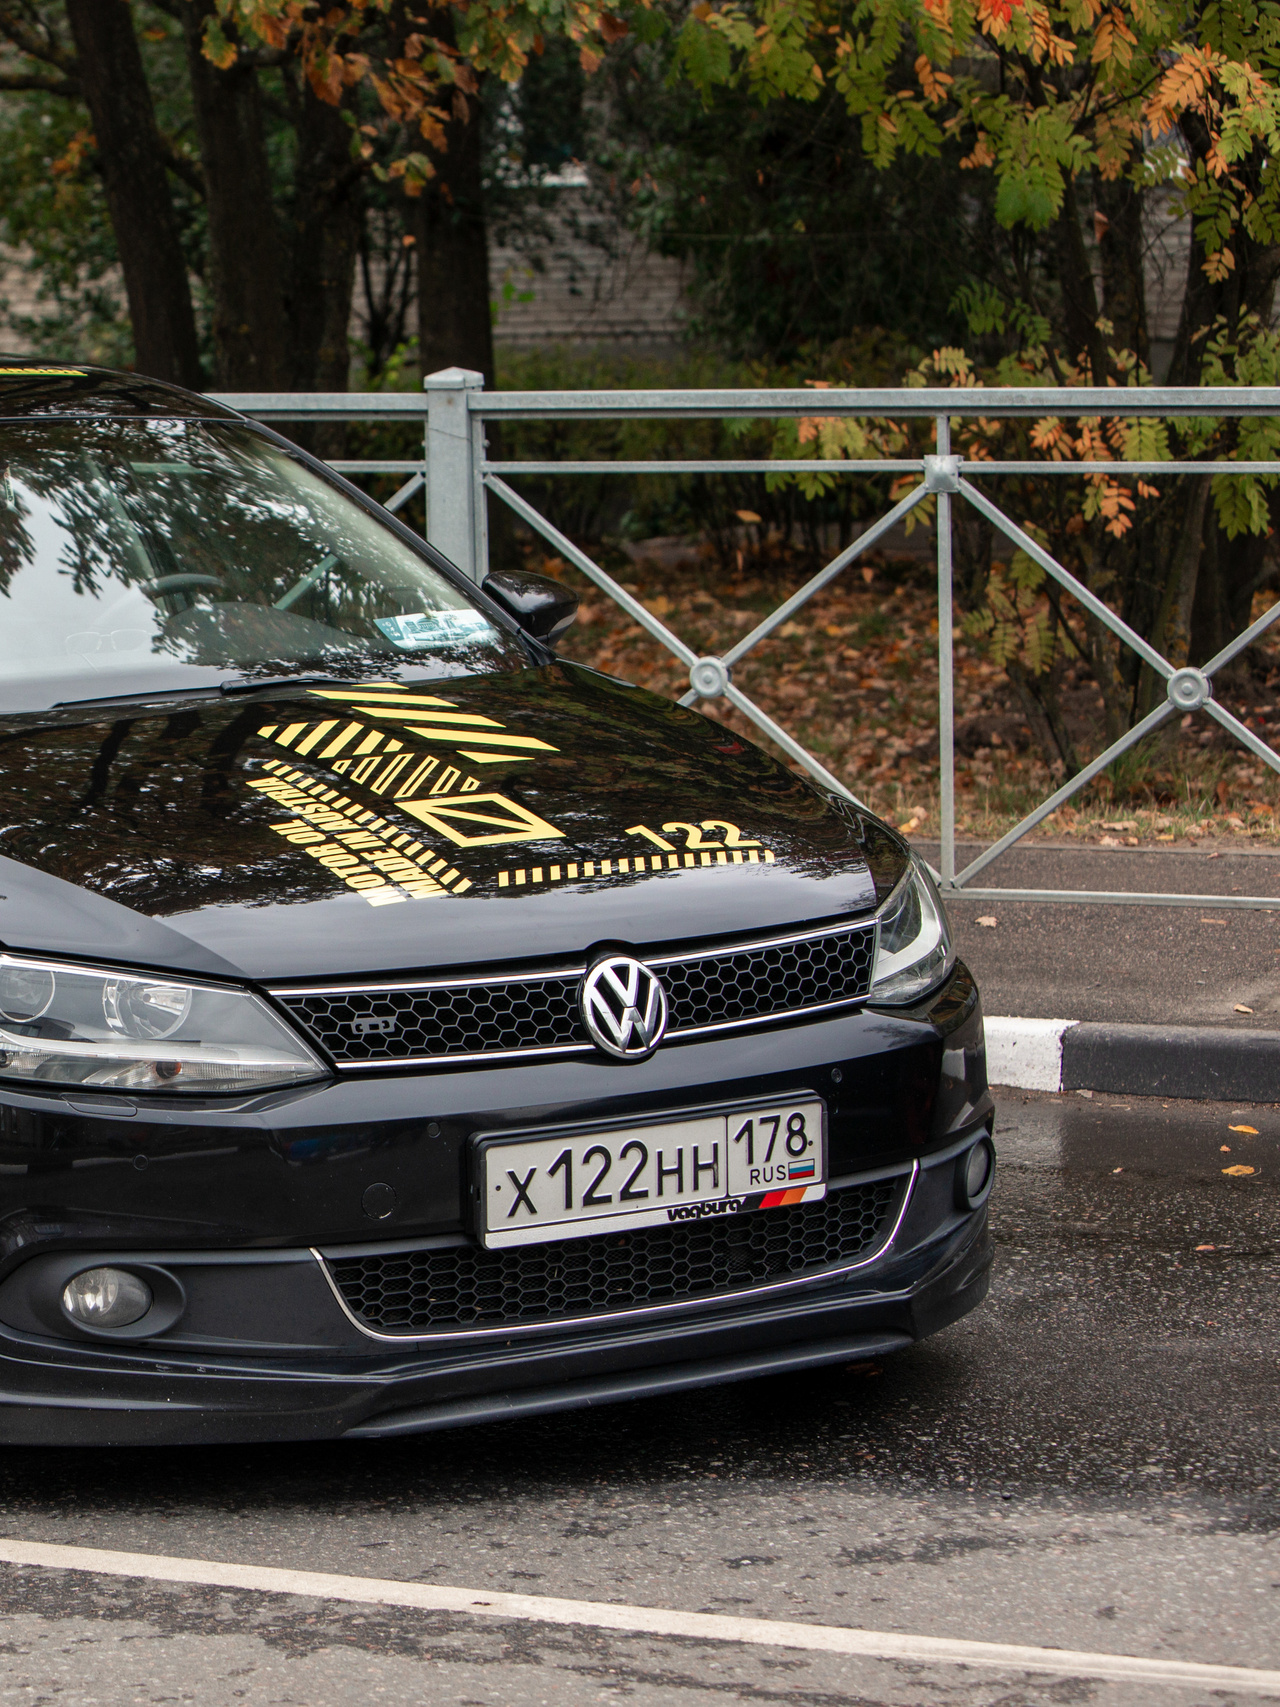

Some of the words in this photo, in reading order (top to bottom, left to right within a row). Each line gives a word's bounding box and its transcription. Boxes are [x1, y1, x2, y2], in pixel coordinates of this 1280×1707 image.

[245, 776, 361, 831] AUSTRIA
[268, 819, 327, 844] OIL
[334, 830, 387, 850] IN
[625, 819, 763, 853] 122
[304, 842, 408, 908] MOTOR
[360, 847, 450, 900] MADE
[732, 1111, 808, 1166] 178
[750, 1164, 787, 1186] RUS
